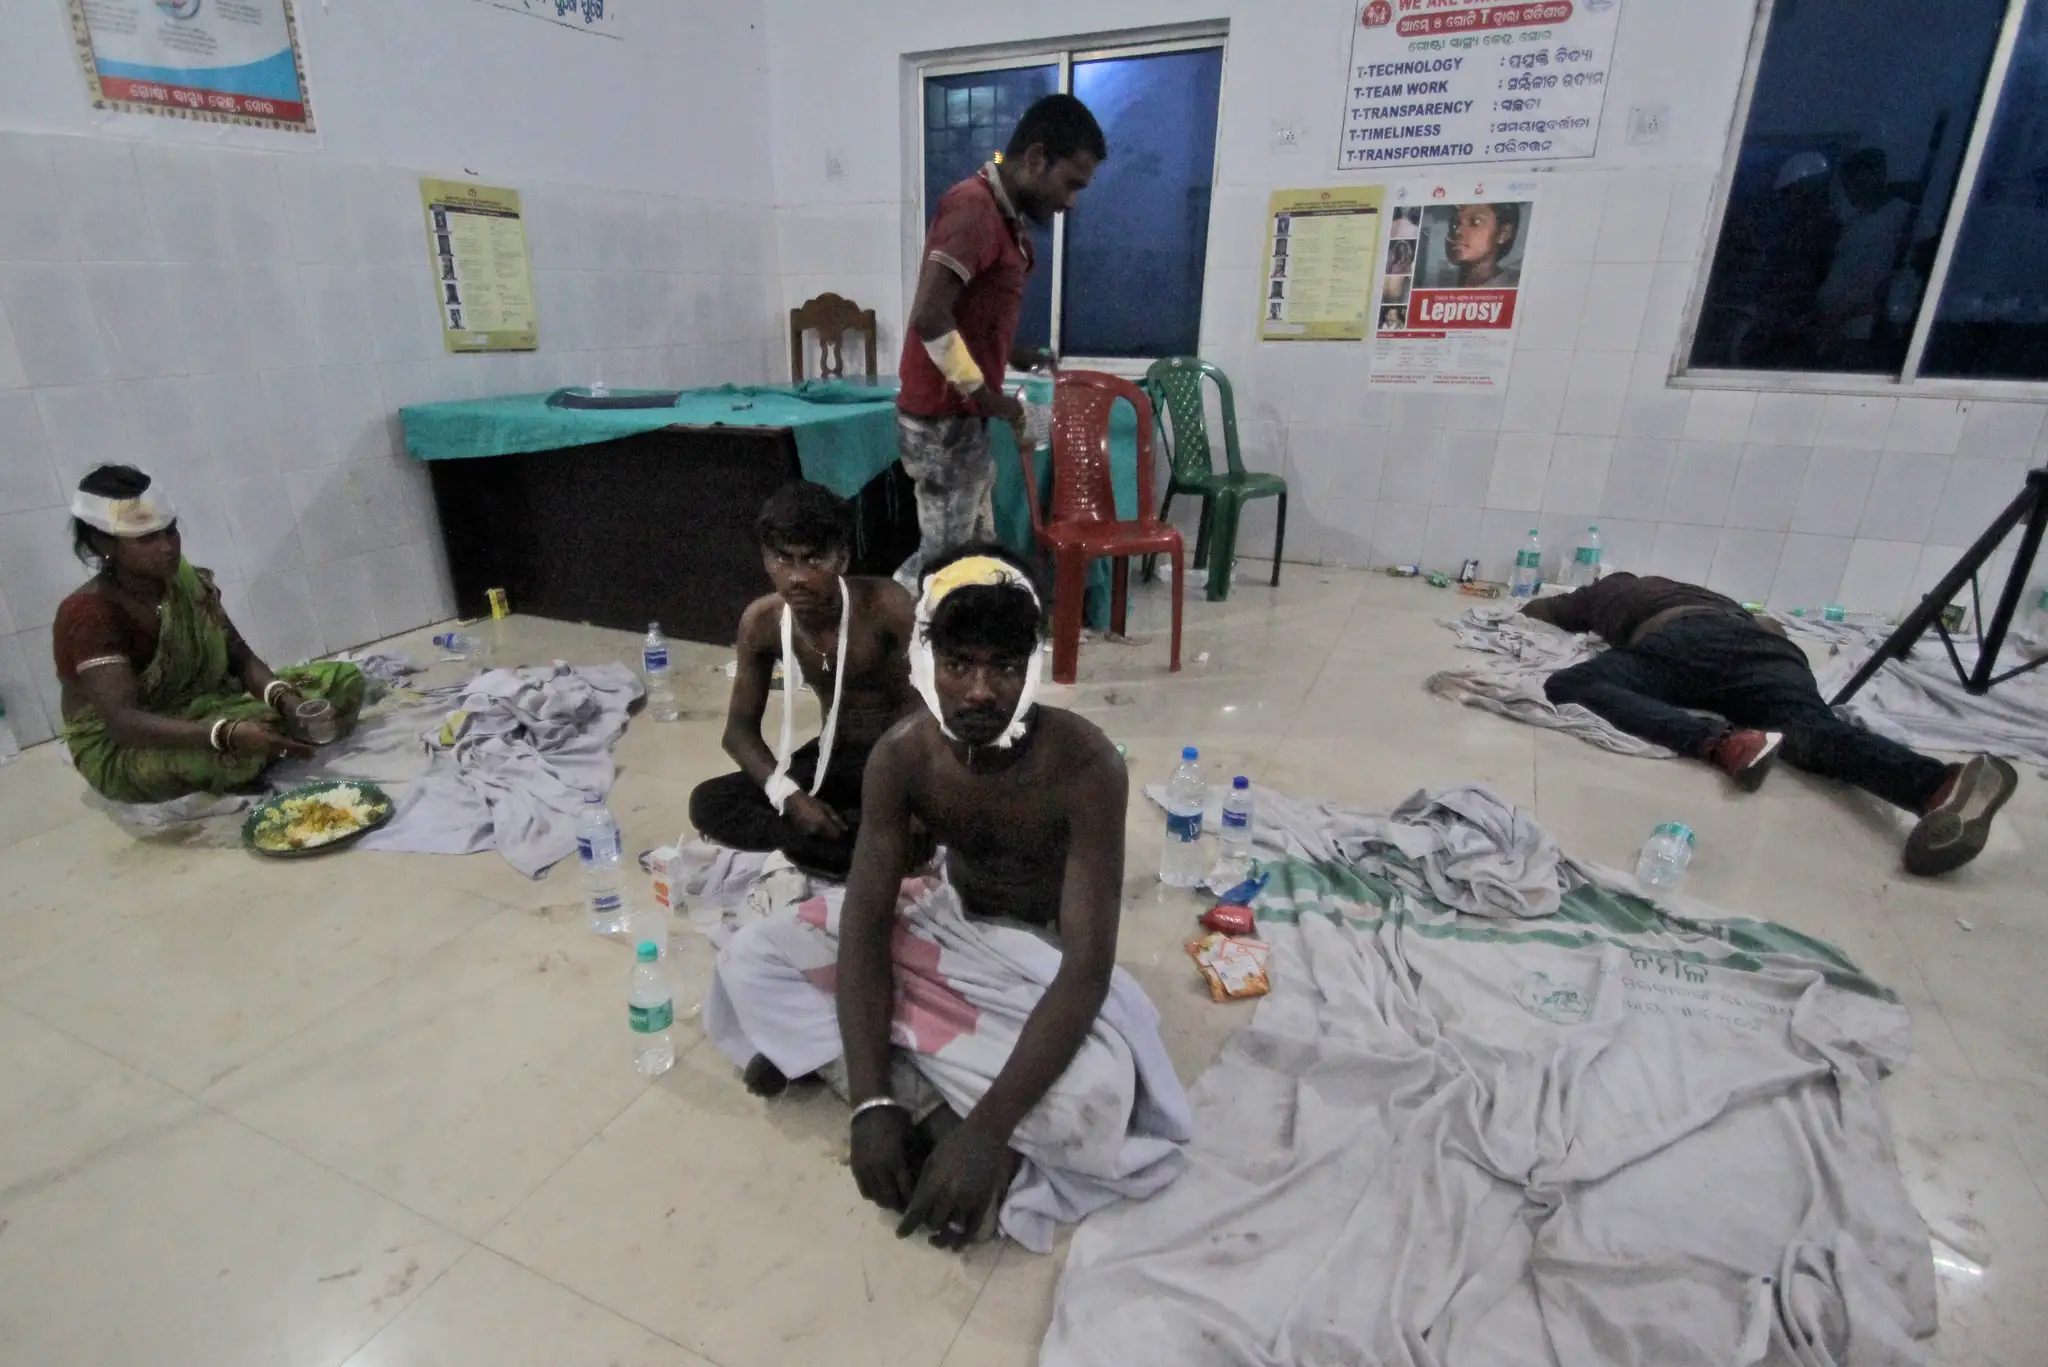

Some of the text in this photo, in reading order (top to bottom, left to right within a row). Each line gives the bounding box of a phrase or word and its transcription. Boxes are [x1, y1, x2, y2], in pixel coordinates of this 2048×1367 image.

[1480, 8, 1490, 24] T
[1356, 57, 1464, 79] T-TECHNOLOGY
[1353, 79, 1449, 100] T-TEAM WORK
[1351, 99, 1474, 121] T-TRANSPARENCY
[1348, 123, 1442, 142] T-TIMELINESS
[1346, 142, 1474, 162] T-TRANSFORMATIO
[1419, 299, 1504, 323] Leprosy
